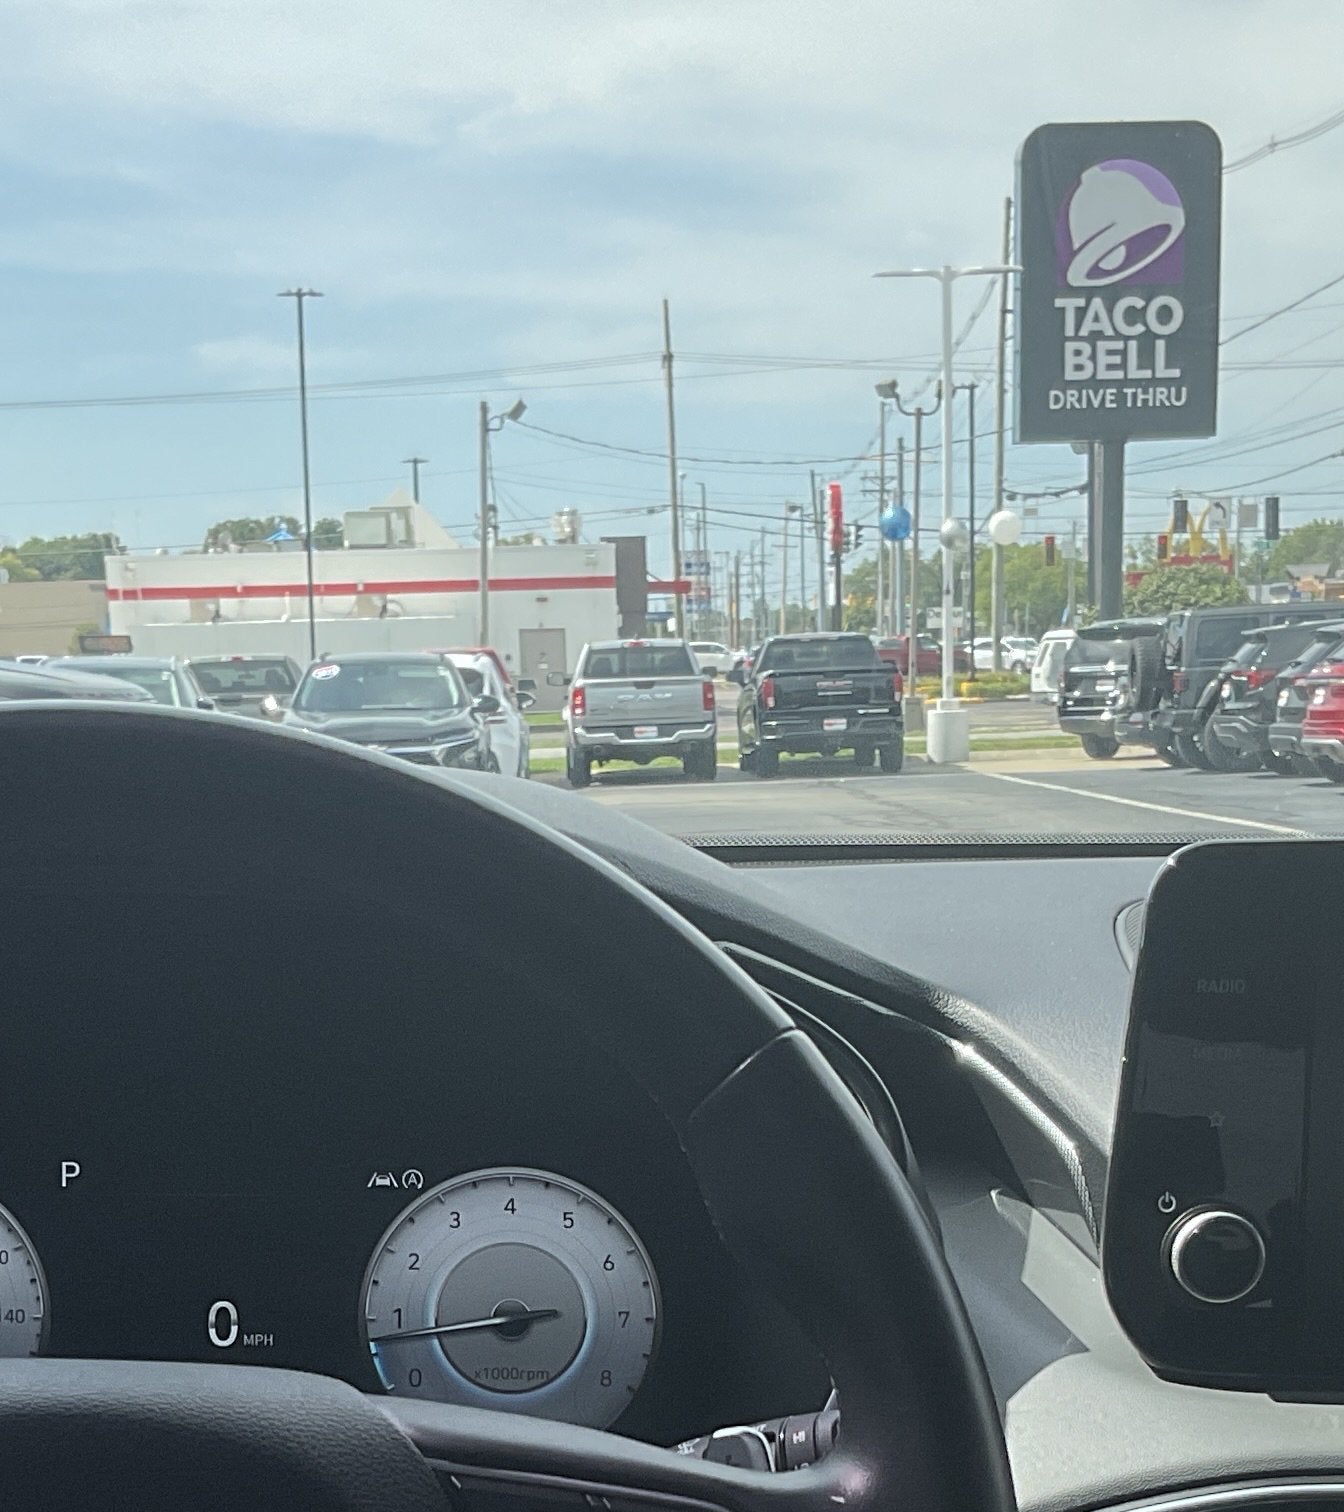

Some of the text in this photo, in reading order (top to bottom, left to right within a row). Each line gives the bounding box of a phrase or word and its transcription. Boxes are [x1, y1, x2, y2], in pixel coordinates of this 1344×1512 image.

[1054, 296, 1184, 336] TACO
[1064, 339, 1181, 381] BELL
[1048, 386, 1187, 410] DRIVE THRU
[1196, 979, 1246, 995] RADIO
[61, 1161, 81, 1187] P
[503, 1198, 516, 1214] 4
[449, 1211, 461, 1229] 3
[562, 1211, 574, 1229] 5
[407, 1253, 420, 1270] 2
[602, 1254, 615, 1272] 6
[208, 1301, 274, 1347] 0 MPH
[392, 1308, 403, 1329] 1
[618, 1311, 630, 1328] 7
[408, 1368, 422, 1388] 0
[473, 1366, 550, 1382] x1000rpm
[600, 1369, 612, 1388] 8
